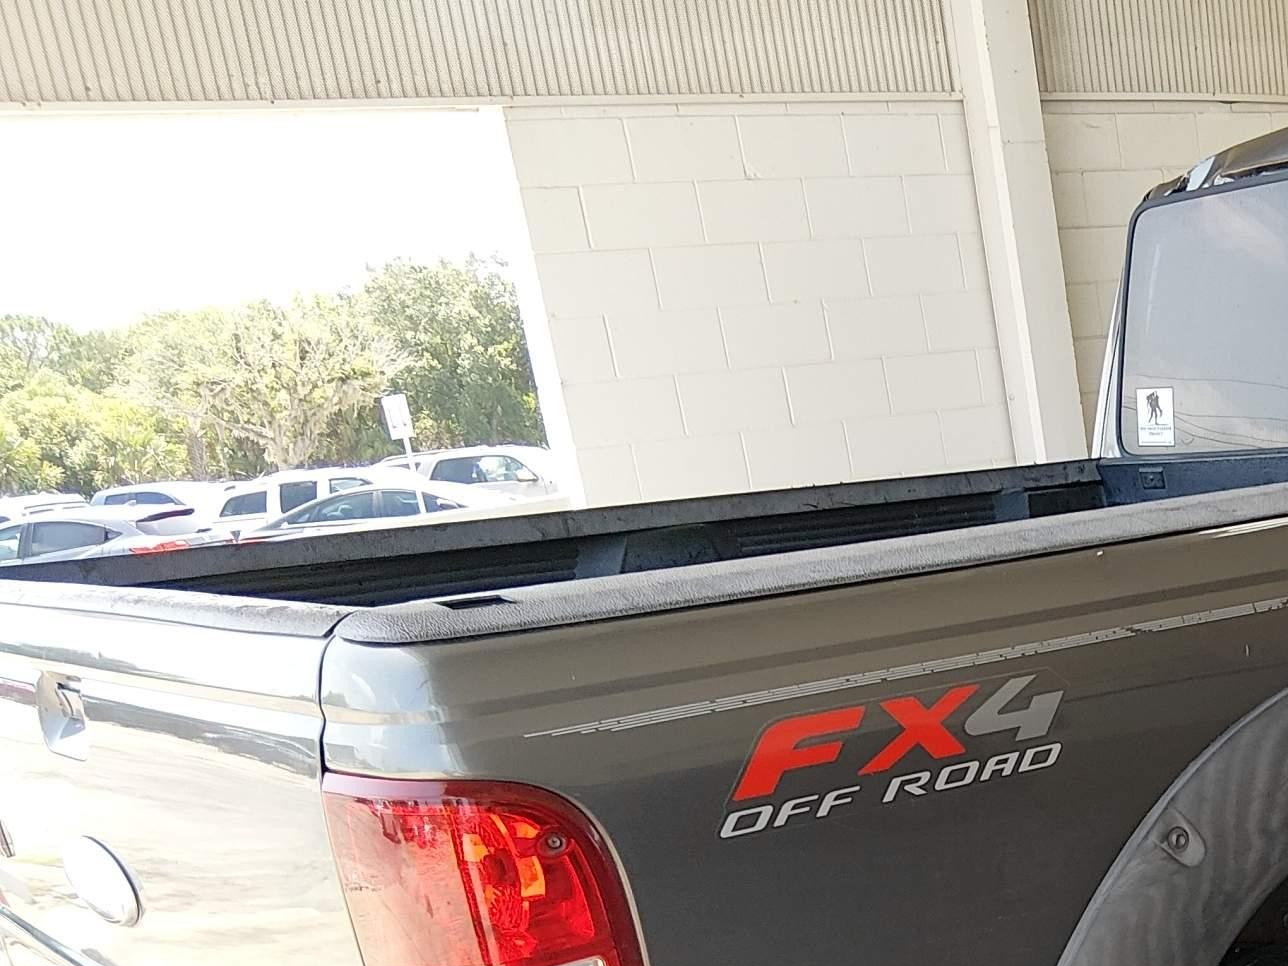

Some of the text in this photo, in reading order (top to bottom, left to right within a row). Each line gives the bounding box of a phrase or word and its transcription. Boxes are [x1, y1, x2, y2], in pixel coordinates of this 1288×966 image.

[719, 742, 1063, 839] OFF ROAD
[732, 674, 1065, 801] FX4
